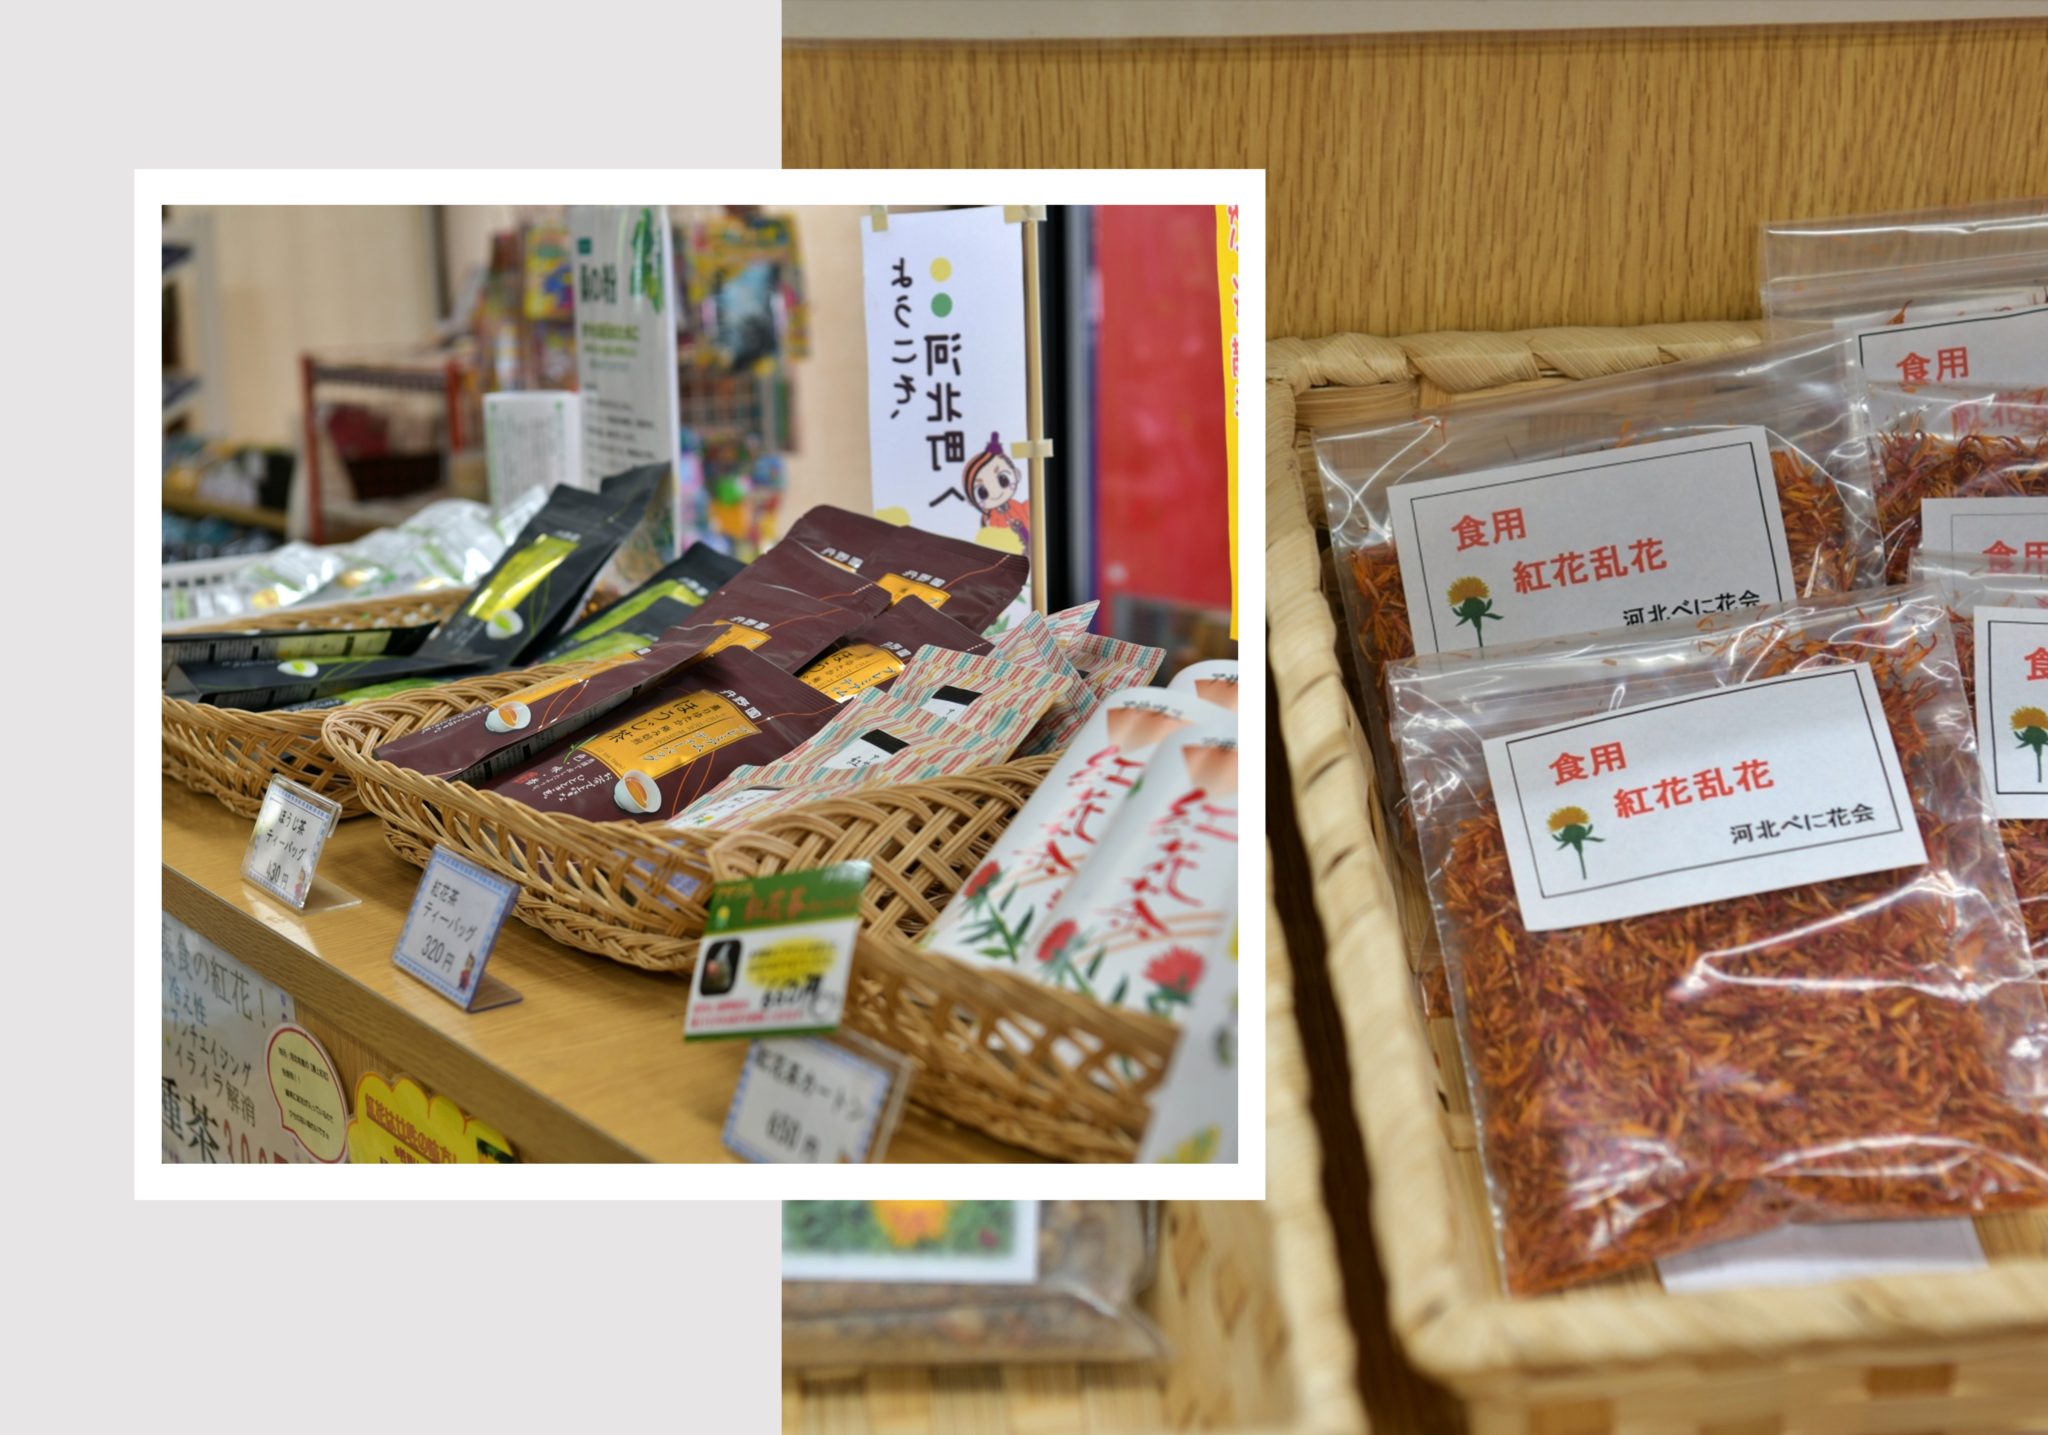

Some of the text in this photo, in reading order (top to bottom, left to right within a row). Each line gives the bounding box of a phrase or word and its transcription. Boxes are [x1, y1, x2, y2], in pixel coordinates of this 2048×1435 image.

[1897, 347, 1969, 387] 食用
[1451, 507, 1527, 551] 食用
[1512, 537, 1668, 595] 紅花乱花
[607, 700, 699, 743] ほうじ茶
[1550, 742, 1626, 786] 食用
[1613, 759, 1775, 819] 紅花乱花
[278, 809, 308, 837] ほうじ茶
[1729, 803, 1876, 845] 河北べに花会
[265, 828, 308, 862] ティーバッグ
[421, 901, 479, 944] ティーバッグ
[176, 1044, 256, 1129] イライラ解消
